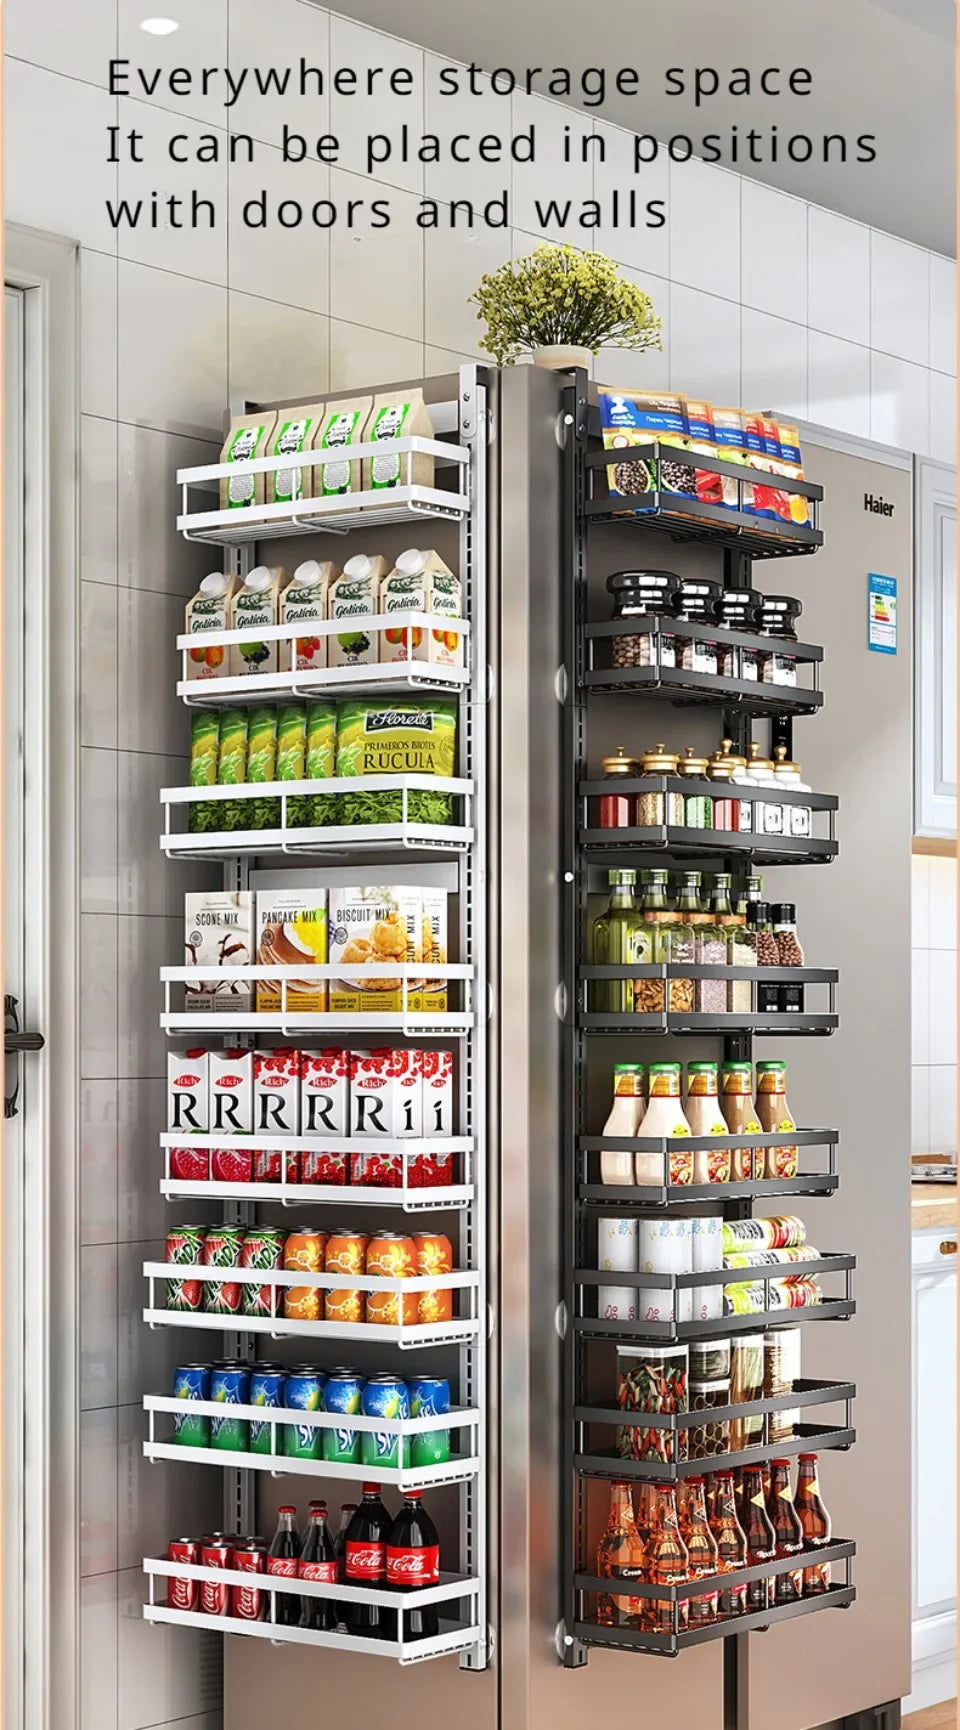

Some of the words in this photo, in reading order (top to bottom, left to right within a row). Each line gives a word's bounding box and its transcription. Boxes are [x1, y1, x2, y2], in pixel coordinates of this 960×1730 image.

[864, 493, 895, 517] Haier
[336, 603, 370, 619] Galicia
[387, 597, 421, 612] Galicia
[237, 614, 270, 629] Galicia
[286, 607, 319, 622] Galicia
[192, 618, 223, 633] Galicia
[364, 741, 410, 751] PRIMEROS
[411, 741, 436, 750] BROTES
[195, 913, 221, 927] SCONE
[224, 912, 239, 925] MIX
[262, 911, 298, 924] PANCAKE
[302, 910, 317, 923] MIX
[336, 909, 371, 923] BISCUIT
[375, 908, 391, 921] MIX
[406, 914, 415, 934] MIX
[431, 916, 440, 935] MIX
[265, 1077, 286, 1087] Rich
[312, 1079, 335, 1088] Rich
[361, 1079, 384, 1088] Rich
[172, 1092, 202, 1128] R
[213, 1093, 244, 1129] R
[258, 1093, 291, 1130] R
[305, 1094, 339, 1131] R
[355, 1095, 388, 1132] R
